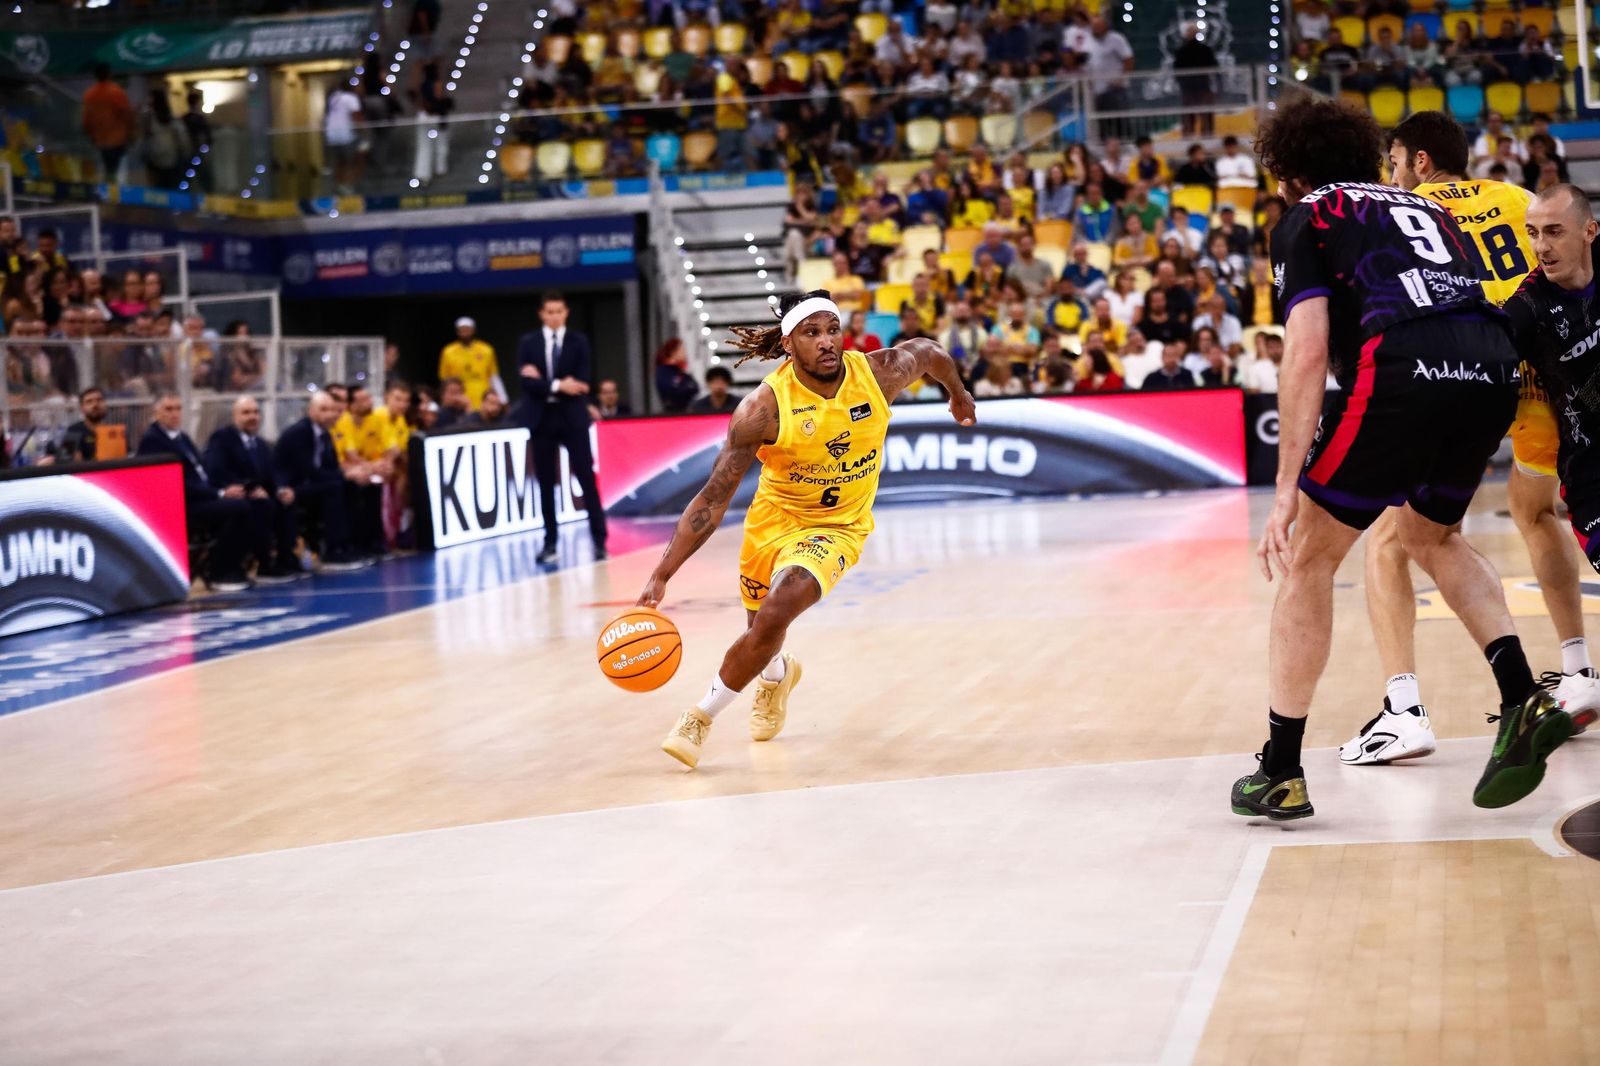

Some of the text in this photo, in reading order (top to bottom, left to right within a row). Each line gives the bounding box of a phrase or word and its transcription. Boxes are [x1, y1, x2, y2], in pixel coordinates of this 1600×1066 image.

[1343, 189, 1445, 213] PULEVA
[1429, 185, 1481, 200] TOBEY
[488, 239, 542, 254] EULEN
[578, 233, 634, 249] EULEN
[1389, 206, 1453, 265] 9
[315, 248, 368, 266] EULEN
[1461, 224, 1529, 281] 18
[1550, 305, 1563, 314] we
[792, 405, 817, 415] SPALDING
[438, 440, 588, 536] KUM
[820, 486, 841, 508] 6
[601, 621, 657, 648] Wilson
[612, 646, 661, 670] liga endesa
